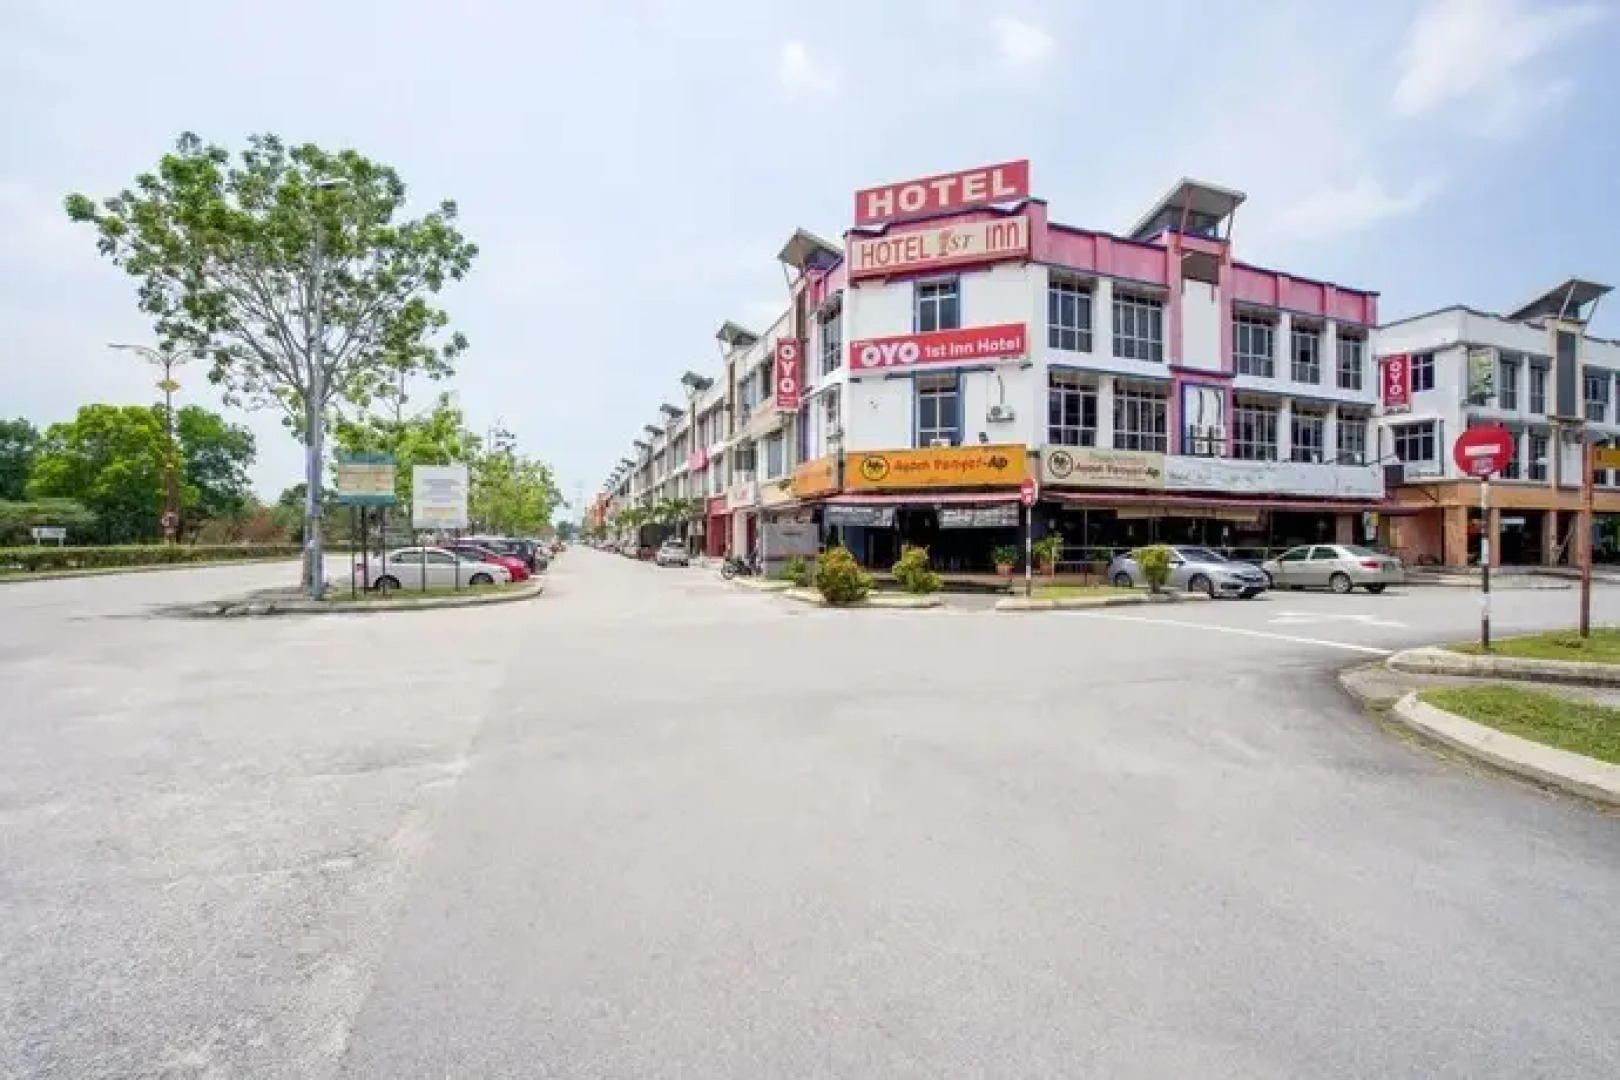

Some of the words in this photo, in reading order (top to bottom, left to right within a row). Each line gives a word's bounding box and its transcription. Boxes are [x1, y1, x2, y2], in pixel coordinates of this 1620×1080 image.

[868, 168, 1017, 218] HOTEL
[861, 235, 930, 268] HOTEL
[780, 344, 796, 393] OYO
[861, 341, 920, 367] OYO
[925, 345, 947, 358] 1st
[950, 342, 974, 356] Inn
[977, 336, 1020, 352] Hotel
